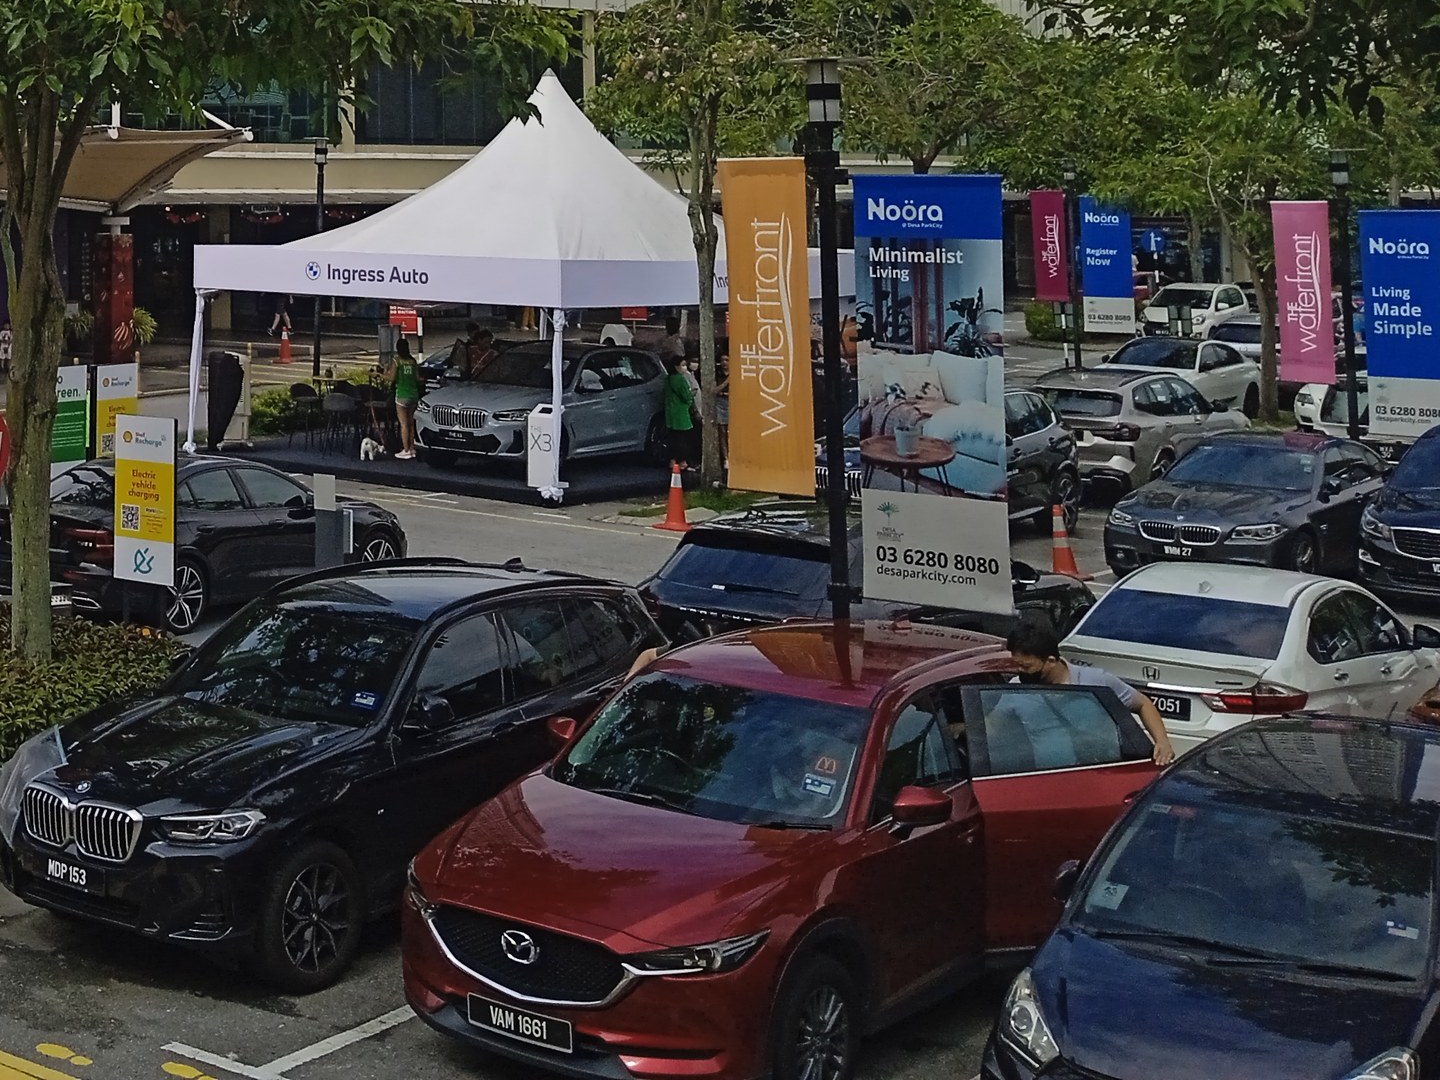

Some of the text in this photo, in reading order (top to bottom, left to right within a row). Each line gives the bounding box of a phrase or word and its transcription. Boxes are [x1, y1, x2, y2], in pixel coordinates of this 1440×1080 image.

[867, 197, 944, 222] Noöra
[1084, 212, 1120, 224] Noöra
[1040, 215, 1058, 278] waterfront
[1085, 247, 1118, 257] Register
[1368, 237, 1430, 255] Noöra
[868, 247, 964, 264] Minimalist
[1086, 257, 1111, 266] Now
[327, 263, 429, 285] Ingress Auto
[869, 266, 910, 282] Living
[1284, 233, 1318, 353] waterfront
[1371, 286, 1411, 301] Living
[1287, 302, 1299, 323] THE
[1373, 302, 1422, 317] Made
[737, 217, 788, 438] waterfront
[1373, 320, 1433, 339] Simple
[740, 343, 757, 381] THE
[1375, 405, 1387, 415] 03
[1390, 406, 1416, 417] 6280
[135, 436, 163, 448] Recharge
[530, 433, 552, 452] X3
[132, 468, 157, 480] Electric
[131, 480, 157, 491] vehicle
[128, 488, 160, 502] charging
[876, 545, 1000, 575] 03 6280 8080
[1181, 547, 1192, 557] 27
[876, 564, 977, 586] desaparkcity.com
[47, 858, 87, 885] MDP 153
[489, 1005, 547, 1040] VAM 1661
